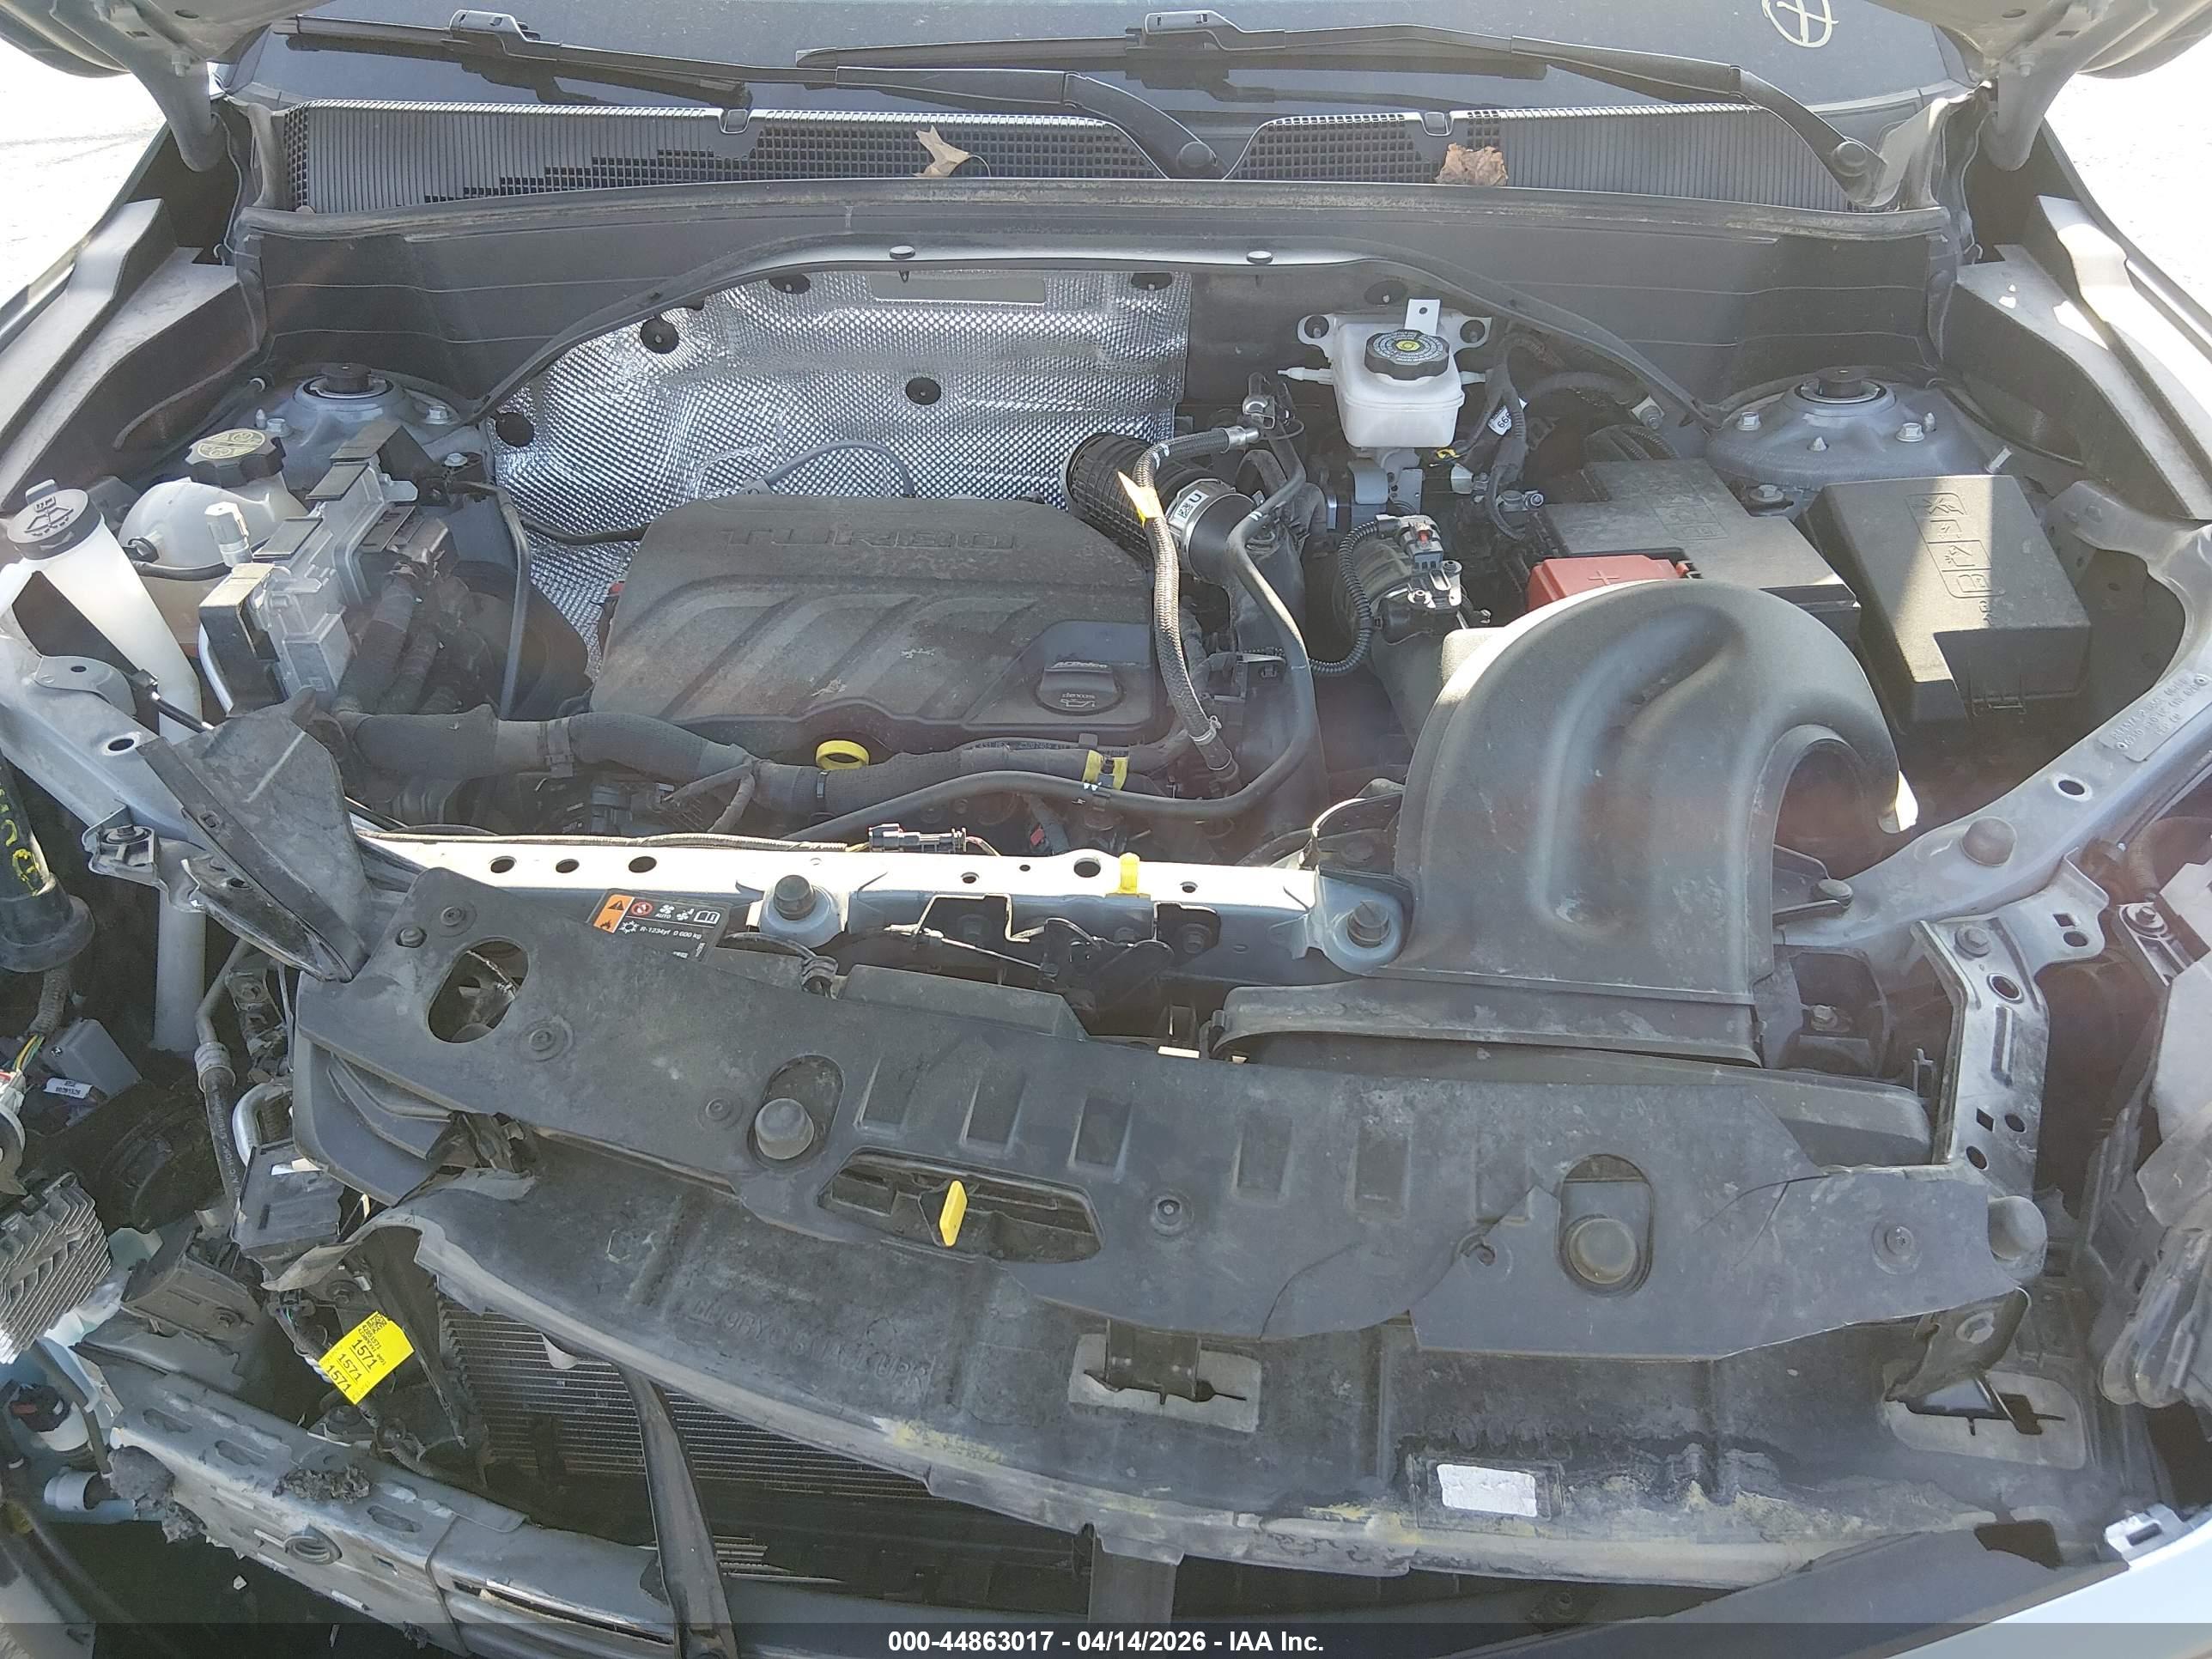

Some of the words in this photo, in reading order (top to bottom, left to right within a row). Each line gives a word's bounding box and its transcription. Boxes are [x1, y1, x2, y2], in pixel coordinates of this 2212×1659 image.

[720, 529, 1016, 550] TURBO
[338, 1353, 362, 1382] 1571
[352, 1339, 377, 1370] 1571
[326, 1364, 351, 1393] 1571
